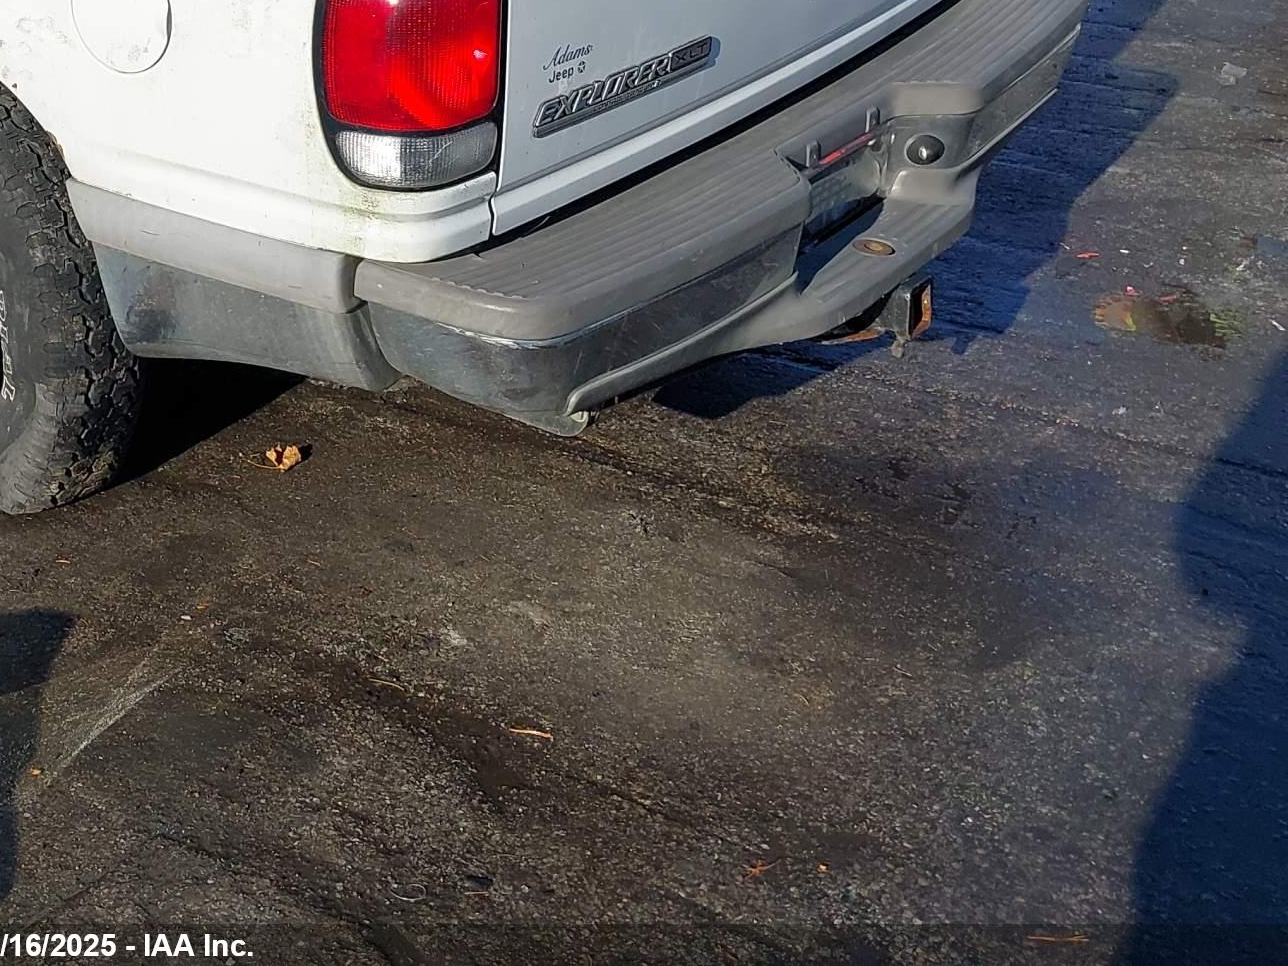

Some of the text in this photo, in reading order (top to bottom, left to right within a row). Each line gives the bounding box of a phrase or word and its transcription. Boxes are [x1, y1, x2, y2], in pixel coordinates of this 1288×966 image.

[542, 43, 593, 71] Adams
[534, 53, 673, 127] EXPLORER
[674, 42, 708, 63] XLT
[548, 65, 574, 83] Jeep
